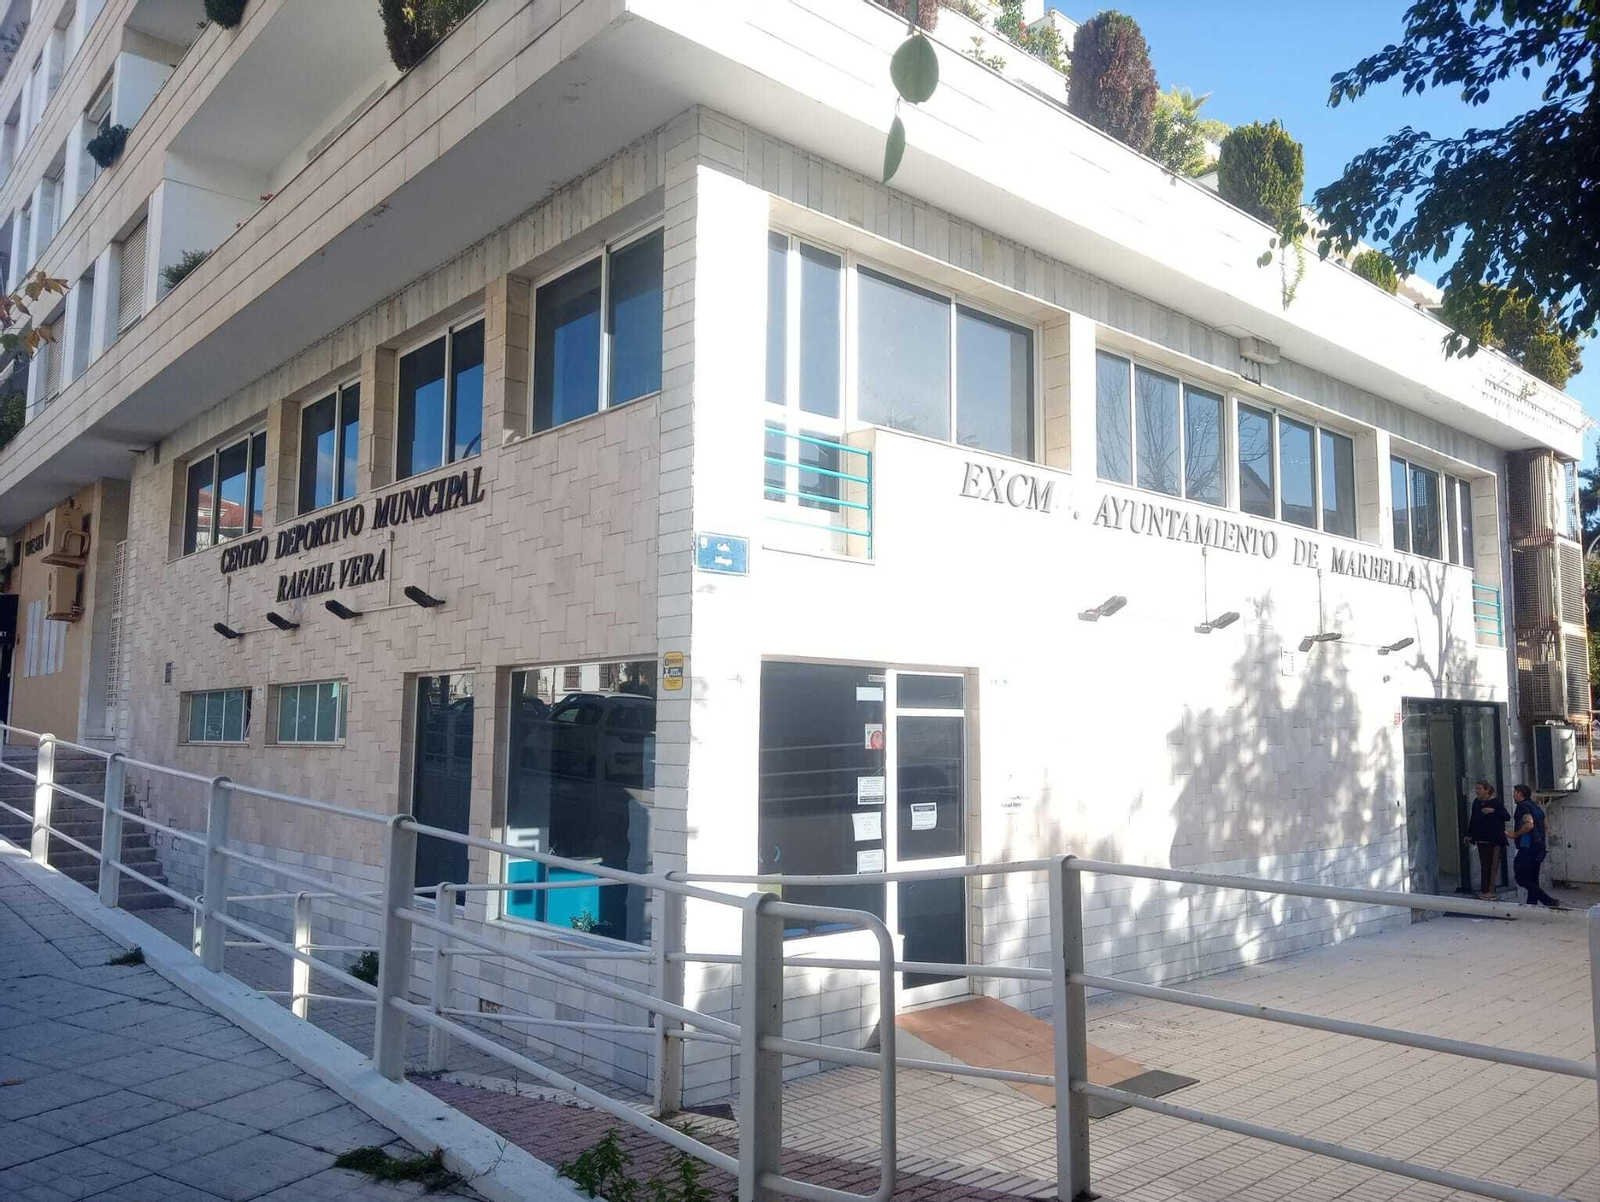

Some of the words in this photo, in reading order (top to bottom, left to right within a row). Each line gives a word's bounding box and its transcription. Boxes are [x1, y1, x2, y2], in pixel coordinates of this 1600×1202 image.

[220, 536, 269, 574] CENTRO
[275, 504, 365, 559] DEPORTIVO
[372, 466, 486, 530] MUNICIPAL
[1092, 493, 1278, 560] AYUNTAMIENTO
[1293, 537, 1319, 569] DE
[1330, 546, 1417, 590] MARBELLA
[276, 562, 335, 602] RAFAEL
[339, 548, 386, 589] VERA
